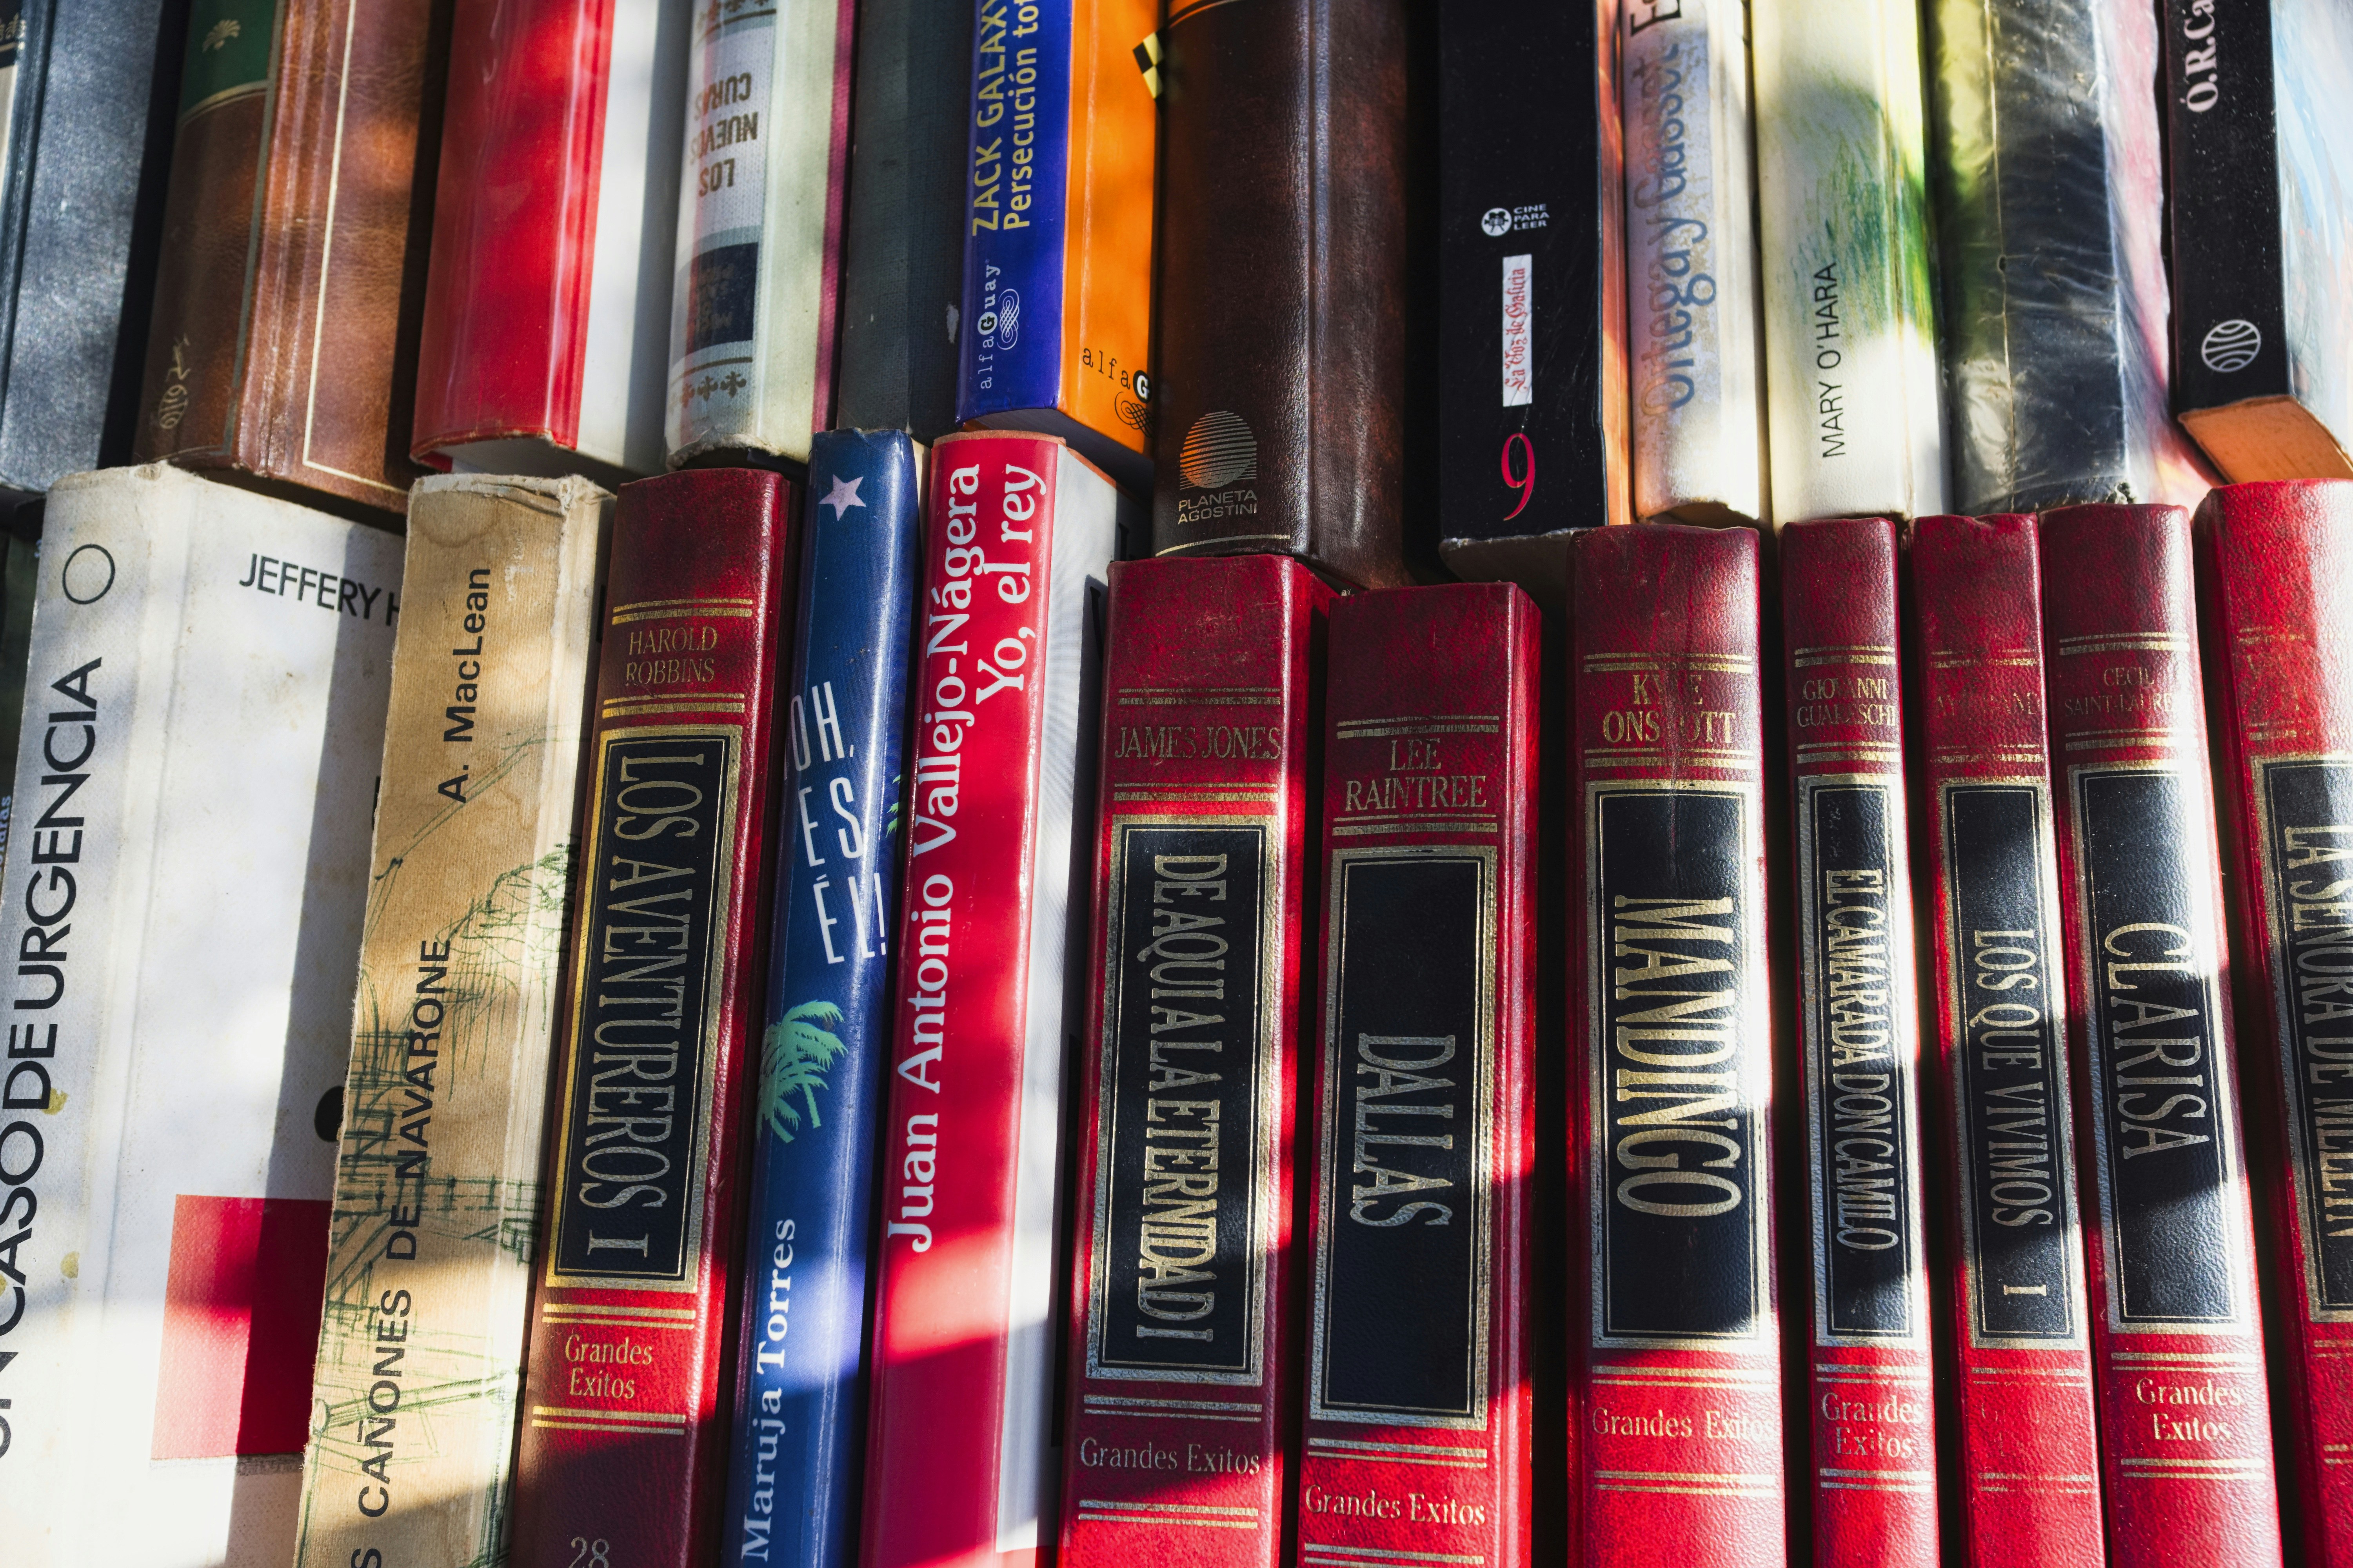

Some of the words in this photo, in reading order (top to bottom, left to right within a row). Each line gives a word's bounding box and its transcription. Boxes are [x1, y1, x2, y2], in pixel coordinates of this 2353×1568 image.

[1003, 47, 1037, 230] Persecución
[699, 158, 735, 197] LOS
[972, 137, 1002, 236] ZACK
[1513, 203, 1547, 214] CINE
[1513, 211, 1550, 223] PARA
[1513, 220, 1547, 231] LEER
[1505, 268, 1528, 318] Galicia
[1814, 261, 1842, 370] O'HARA
[1506, 320, 1525, 335] de
[1641, 249, 1716, 417] Ortega
[1819, 382, 1846, 459] MARY
[1000, 463, 1047, 544] rey
[1178, 489, 1257, 512] PLANETA
[1501, 432, 1536, 521] 9
[1177, 503, 1257, 525] AGOSTINI
[238, 553, 381, 620] JEFFERY
[983, 561, 1031, 604] el
[443, 568, 491, 743] MacLean
[629, 626, 718, 656] HAROLD
[913, 463, 985, 858] Vallejo-Nágera
[976, 626, 1036, 705] Yo,
[625, 658, 716, 687] ROBBINS
[1633, 674, 1703, 705] KE
[1802, 678, 1888, 701] GIONNI
[784, 681, 854, 780] OH,
[1603, 710, 1736, 744] ONSOTT
[1797, 703, 1896, 728] GUASCHI
[1115, 727, 1197, 759] JAMES
[1202, 726, 1281, 760] JONES
[1390, 738, 1442, 771] LEE
[438, 764, 470, 804] A.
[614, 753, 704, 840] LOS
[1345, 775, 1487, 812] RAINTREE
[14, 657, 102, 1009] URGENCIA
[798, 777, 863, 867] ES
[1154, 854, 1227, 904] DE
[1826, 869, 1884, 904] EL
[813, 873, 887, 965] ÉL!
[1137, 908, 1229, 1001] AQUI
[1974, 929, 2038, 991] LOS
[898, 874, 954, 1094] Antonio
[1826, 906, 1890, 1067] CAMARADA
[579, 855, 696, 1208] AVENTUREROS
[1150, 1005, 1226, 1034] A
[1969, 1003, 2042, 1071] QUE
[2104, 922, 2211, 1160] CLARISA
[2, 1024, 58, 1109] DE
[395, 940, 451, 1179] NAVARONE
[1149, 1040, 1223, 1092] LA
[1615, 895, 1742, 1218] MANDINGO
[1350, 1033, 1456, 1227] DALLAS
[1833, 1073, 1892, 1135] DON
[1984, 1081, 2053, 1227] VIVIMOS
[888, 1112, 939, 1254] Juan
[1137, 1098, 1221, 1322] ETERNIDAD
[1834, 1138, 1899, 1250] CAMILO
[386, 1204, 422, 1261] DE
[587, 1229, 649, 1259] I
[756, 1218, 796, 1375] Torres
[2003, 1284, 2047, 1297] I
[565, 1333, 653, 1365] Grandes
[1136, 1324, 1214, 1342] I
[357, 1289, 412, 1518] CAÑONES
[569, 1367, 635, 1400] Exitos
[1822, 1392, 1922, 1424] Grandes
[2136, 1377, 2243, 1406] Grandes
[1592, 1407, 1692, 1437] Grandes
[1706, 1410, 1775, 1442] Exitos
[1835, 1426, 1913, 1458] Exitos
[2153, 1412, 2233, 1442] Exitos
[741, 1387, 787, 1562] Maruja
[1080, 1437, 1177, 1470] Grandes
[1187, 1444, 1260, 1475] Exitos
[1305, 1484, 1401, 1519] Grandes
[1408, 1492, 1485, 1526] Exitos
[568, 1537, 609, 1568] 28
